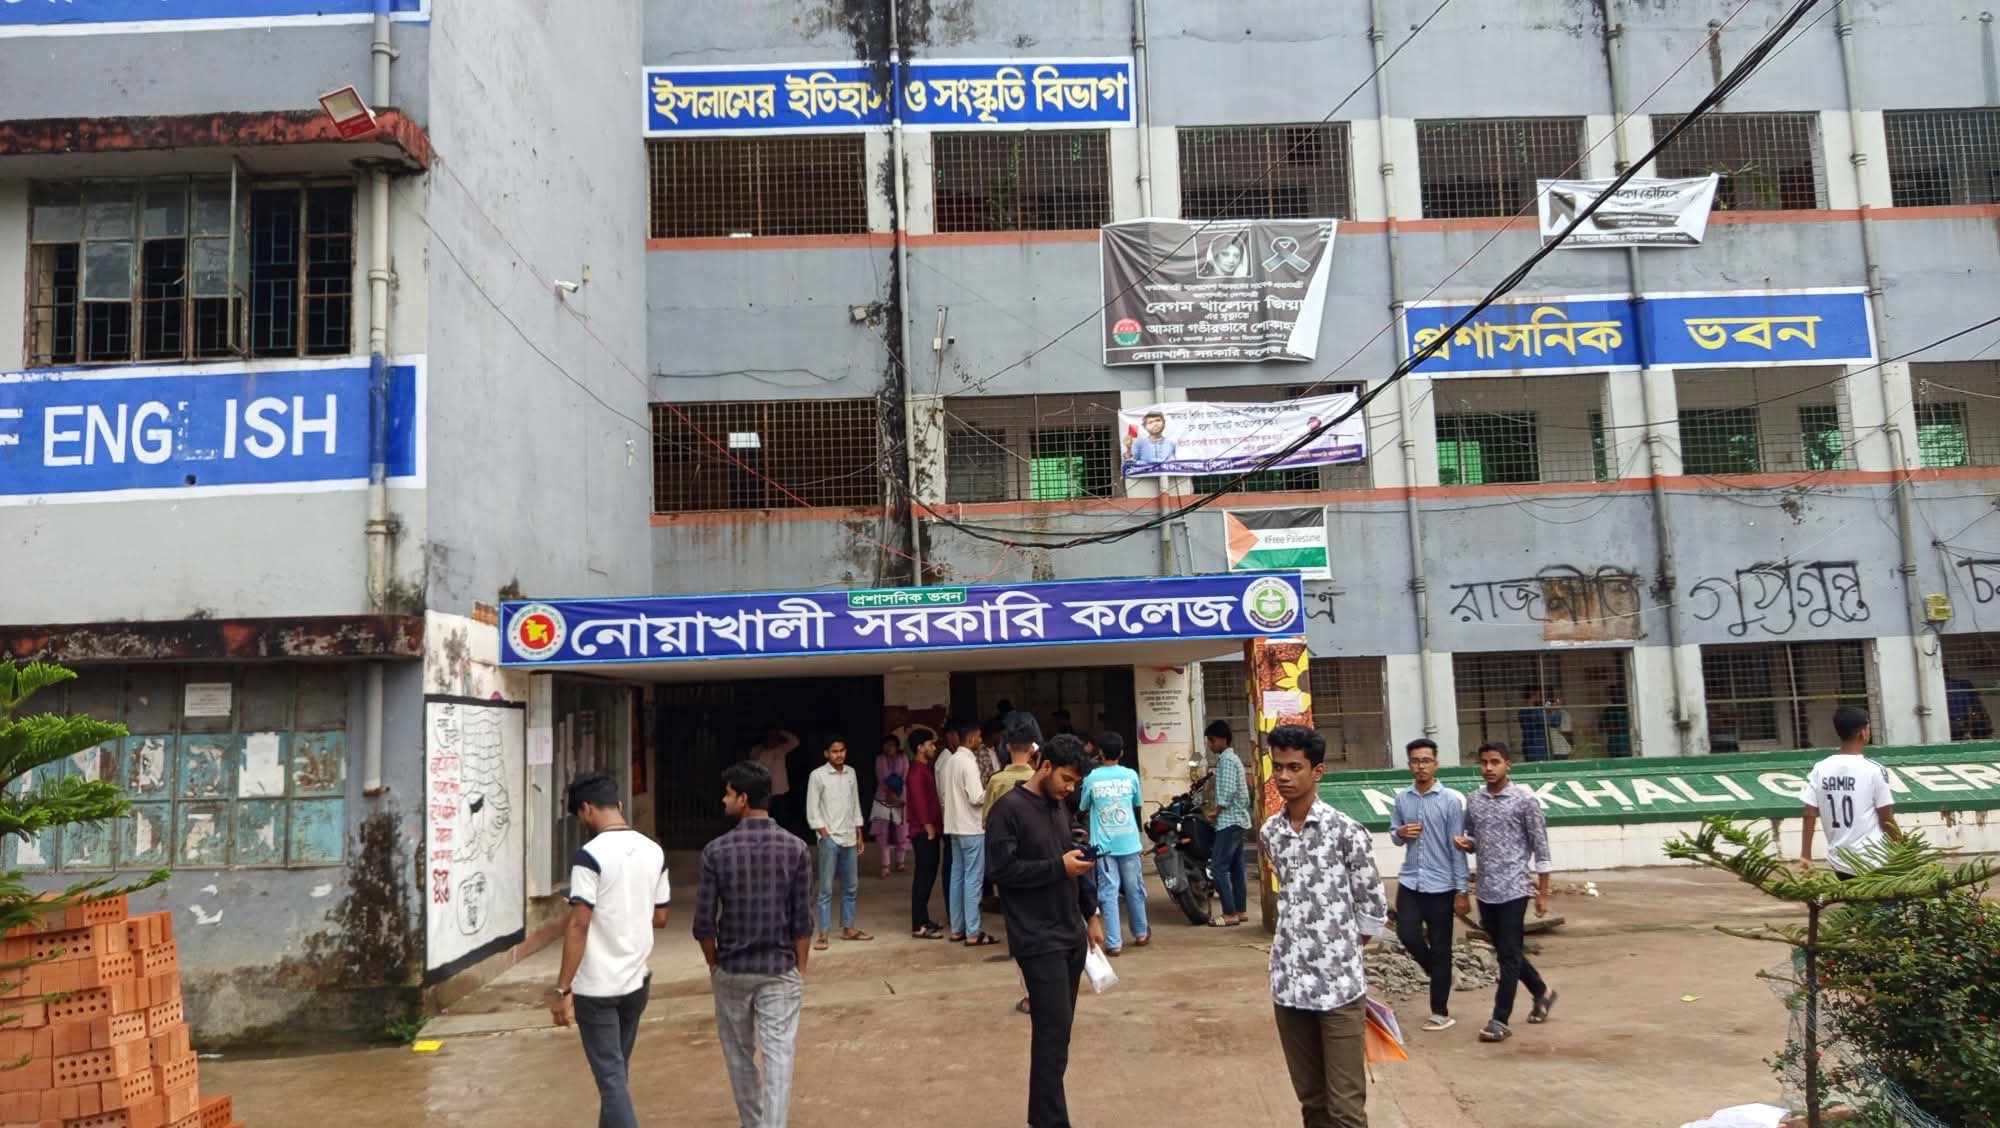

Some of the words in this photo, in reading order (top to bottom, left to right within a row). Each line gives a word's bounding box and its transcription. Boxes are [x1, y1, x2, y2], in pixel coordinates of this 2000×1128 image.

[652, 76, 777, 124] ইসলামের
[904, 81, 927, 112] ও
[928, 66, 1026, 123] সংস্কৃতি
[1031, 66, 1128, 112] বিভাগ
[1145, 301, 1194, 314] বেগম
[1199, 300, 1260, 313] খালেদা
[1146, 323, 1184, 335] আমরা
[1188, 320, 1247, 334] গভীরভাবে
[1413, 306, 1623, 361] প্রশাসনিক
[1685, 315, 1822, 350] ভবন
[1132, 347, 1190, 361] নোয়াখালী
[1196, 346, 1241, 359] সরকারি
[43, 394, 336, 467] ENGISH
[851, 591, 923, 604] প্রশাসনিক
[926, 592, 962, 602] ভবন
[571, 598, 836, 656] নোয়াখালী
[848, 591, 1051, 645] সরকারি
[1063, 594, 1240, 636] কলেজ
[1361, 774, 1744, 816] NKHALI
[1822, 776, 1856, 791] SAMIR
[1827, 794, 1854, 828] 10
